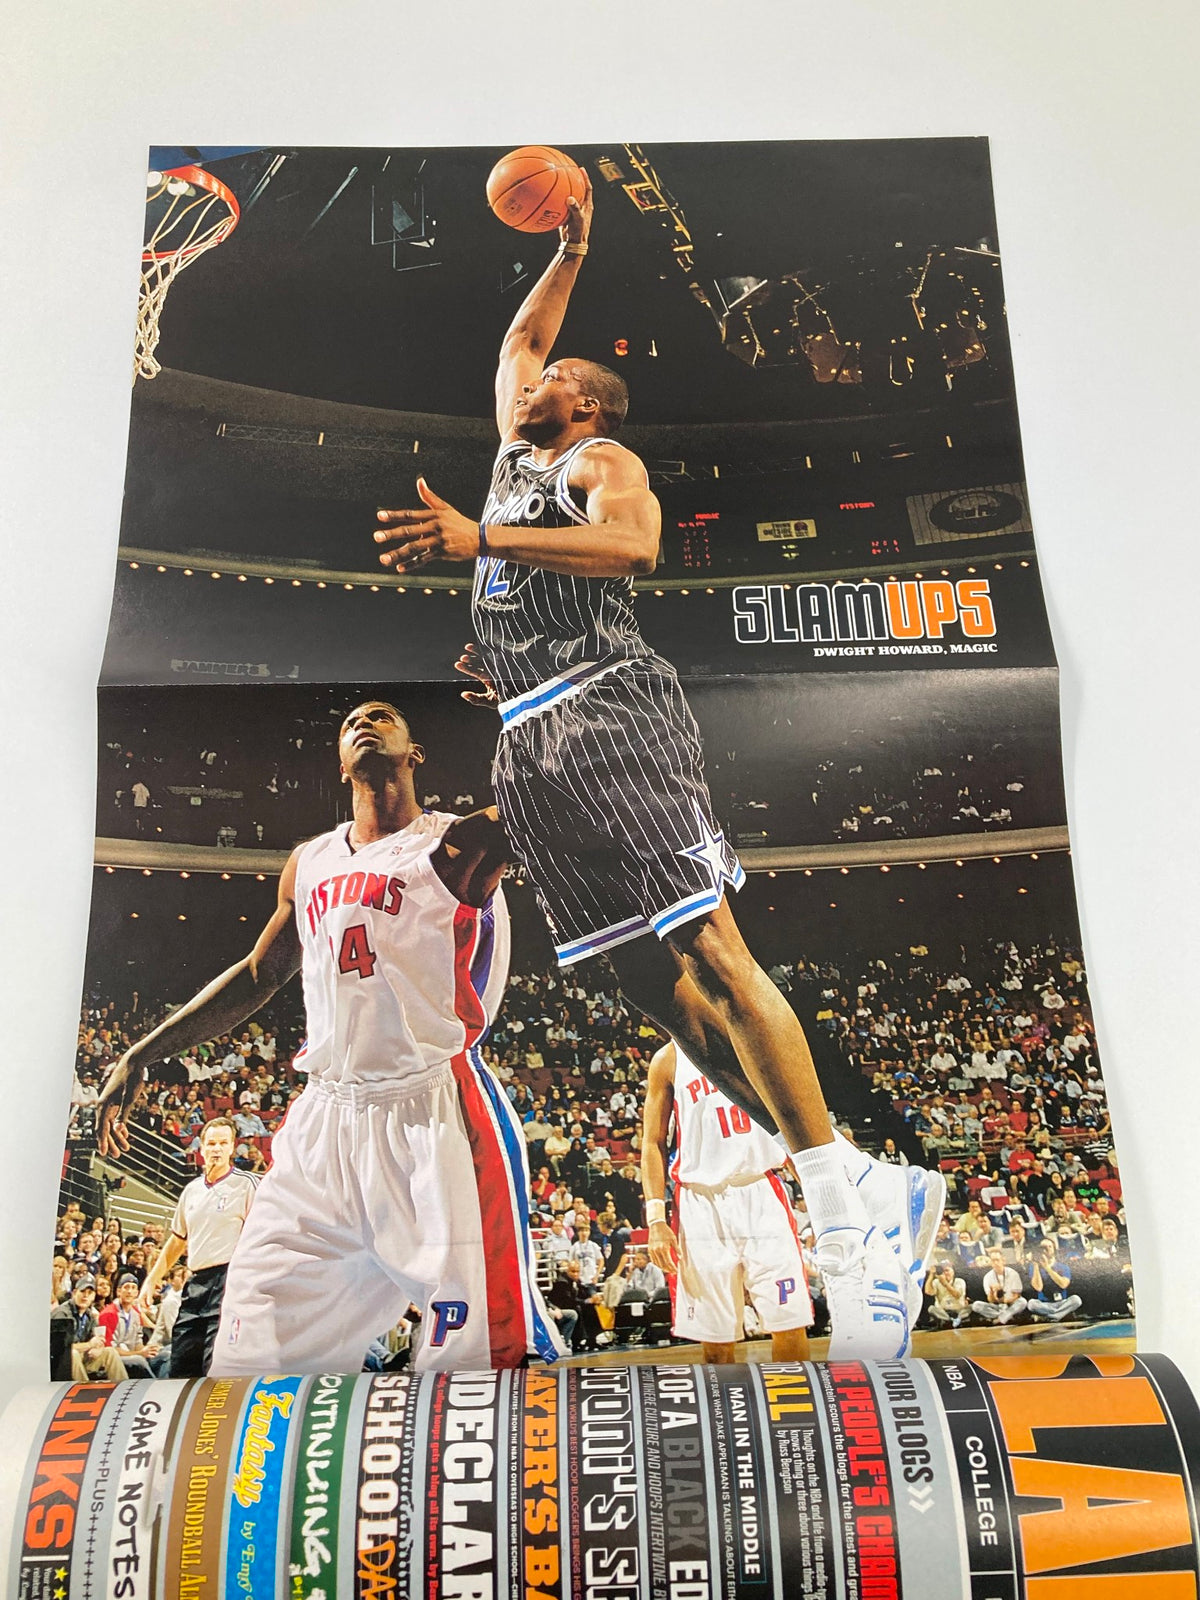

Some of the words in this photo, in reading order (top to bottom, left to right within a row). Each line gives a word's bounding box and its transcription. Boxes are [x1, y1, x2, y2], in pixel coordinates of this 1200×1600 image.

[813, 646, 876, 658] DWIGHT
[878, 644, 948, 656] HOWARD,
[950, 643, 998, 654] MAGIC
[716, 1104, 752, 1139] 10
[829, 1361, 868, 1382] THE
[942, 1365, 967, 1391] NBA
[642, 1383, 657, 1406] WHERE
[658, 1379, 696, 1404] OF
[710, 1384, 720, 1398] SURE
[821, 1369, 837, 1403] Rubenstein
[882, 1371, 919, 1402] OUR
[713, 1399, 723, 1419] WHAT
[729, 1387, 747, 1421] MAN
[569, 1404, 578, 1435] WORLD'S
[644, 1407, 660, 1447] CULTURE
[661, 1411, 698, 1429] A
[828, 1404, 841, 1433] scours
[125, 1401, 161, 1470] GAME
[716, 1421, 726, 1440] JAKE
[734, 1427, 751, 1447] IN
[775, 1430, 789, 1439] by
[790, 1429, 802, 1452] knows
[834, 1434, 845, 1450] the
[232, 1391, 294, 1508] Fantasy
[429, 1442, 440, 1463] gets
[510, 1446, 518, 1460] NBA
[570, 1437, 578, 1455] BEST
[778, 1439, 791, 1457] Russ
[801, 1429, 817, 1462] Thoughts
[837, 1386, 891, 1507] PEOPLE'S
[891, 1407, 935, 1484] BLOGS
[25, 1384, 117, 1549] LINKS
[357, 1375, 410, 1552] SCHOOL
[510, 1462, 518, 1471] TO
[646, 1447, 661, 1469] AND
[717, 1442, 730, 1489] APPLEMAN
[792, 1459, 806, 1479] thing
[806, 1463, 816, 1473] on
[836, 1452, 849, 1481] blogs
[570, 1457, 579, 1484] HOOP
[737, 1452, 755, 1489] THE
[779, 1458, 793, 1494] Bengtson
[808, 1474, 820, 1487] the
[428, 1475, 440, 1498] blog
[510, 1473, 518, 1510] OVERSEAS
[648, 1471, 663, 1509] HOOPS
[663, 1437, 707, 1552] BLACK
[722, 1491, 730, 1500] IS
[795, 1480, 805, 1489] or
[809, 1488, 822, 1504] NBA
[840, 1483, 852, 1499] for
[965, 1436, 998, 1547] COLLEGE
[571, 1486, 580, 1536] BLOGGERS
[797, 1490, 809, 1511] three
[843, 1501, 854, 1519] the
[181, 1465, 217, 1569] ROUNDBALL
[510, 1512, 518, 1522] TO
[722, 1502, 733, 1543] TALKING
[811, 1505, 824, 1520] and
[240, 1521, 257, 1540] by
[740, 1496, 761, 1575] MIDDLE
[799, 1513, 811, 1536] about
[812, 1521, 825, 1535] life
[113, 1481, 144, 1599] NOTES
[813, 1536, 826, 1554] from
[844, 1522, 857, 1554] latest
[572, 1538, 581, 1574] BRINGS
[725, 1545, 735, 1579] ABOUT
[801, 1537, 814, 1567] various
[428, 1563, 439, 1578] by
[847, 1556, 859, 1577] and
[573, 1575, 581, 1592] HIS
[801, 1568, 815, 1593] things
